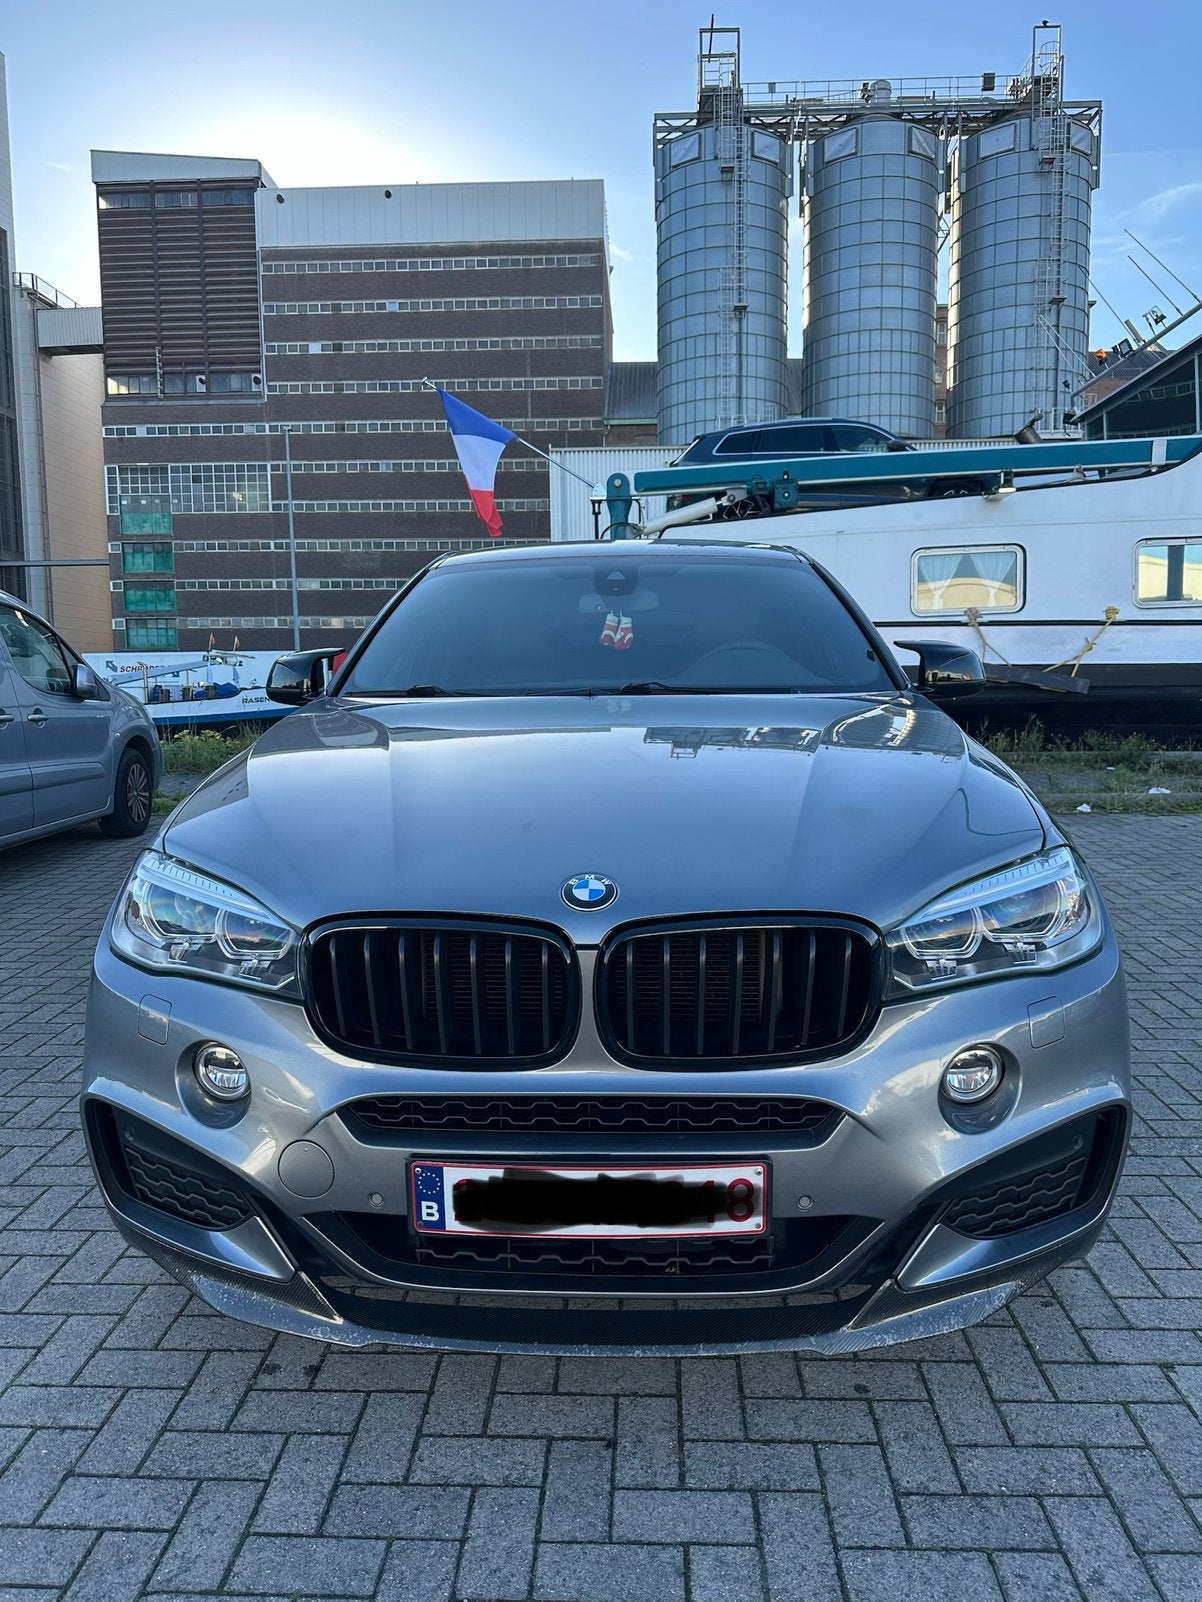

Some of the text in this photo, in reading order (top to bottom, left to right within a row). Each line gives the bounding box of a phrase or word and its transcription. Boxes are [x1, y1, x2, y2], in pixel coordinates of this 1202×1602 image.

[120, 665, 165, 673] SCHRD
[569, 874, 611, 885] BMW
[421, 1201, 440, 1222] B
